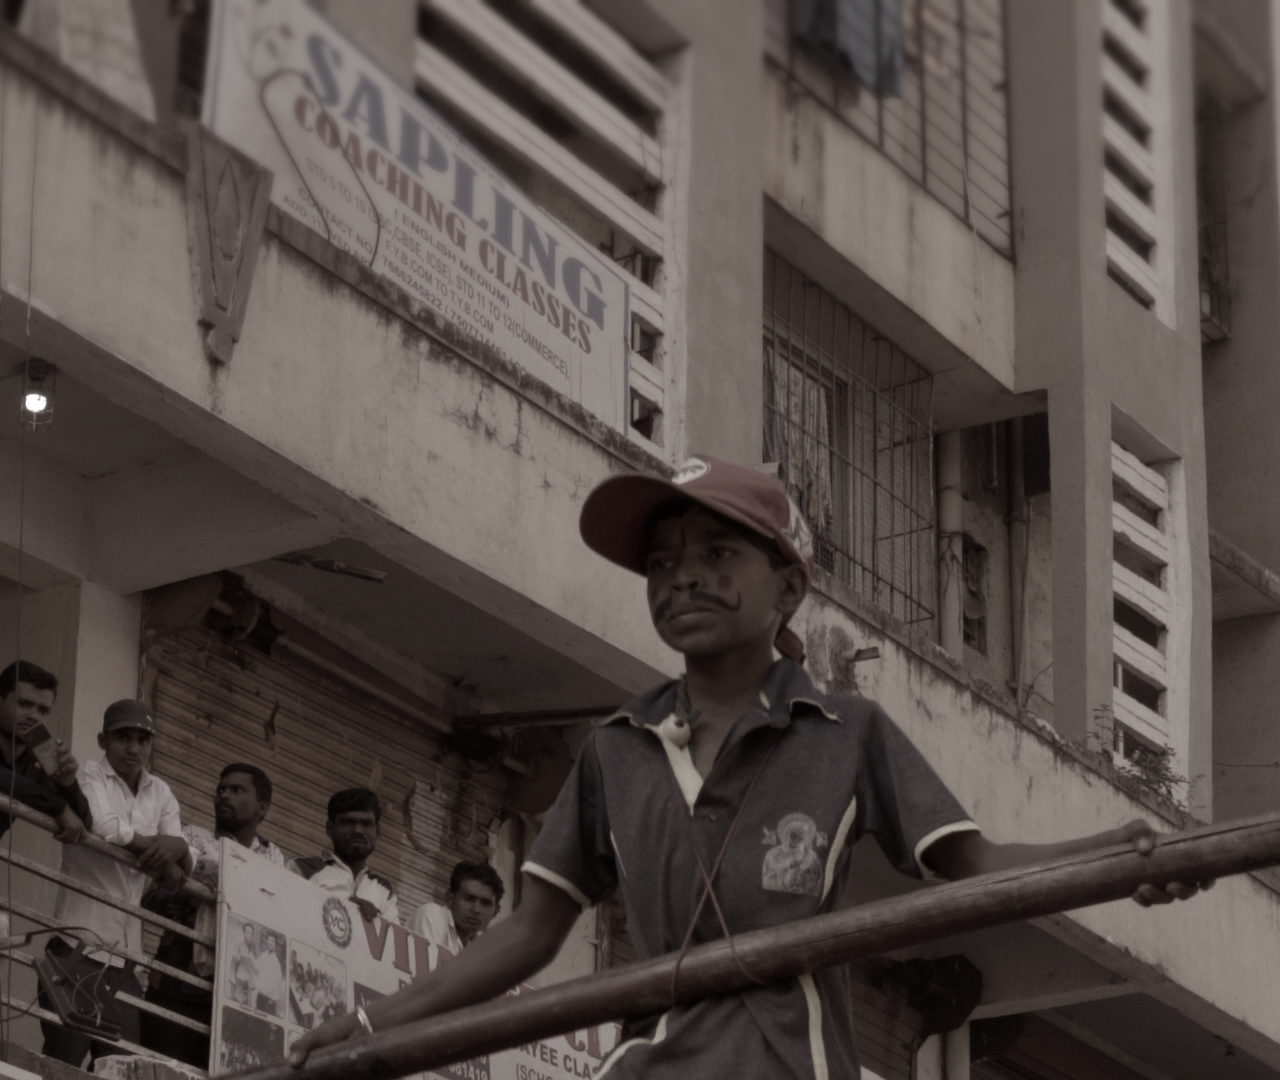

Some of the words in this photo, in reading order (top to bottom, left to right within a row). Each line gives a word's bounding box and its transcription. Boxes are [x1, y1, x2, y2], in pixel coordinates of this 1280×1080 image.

[293, 94, 468, 252] COACHING
[478, 238, 592, 354] CLASSES
[305, 32, 607, 331] SAPLING
[402, 214, 456, 262] ENGLISH
